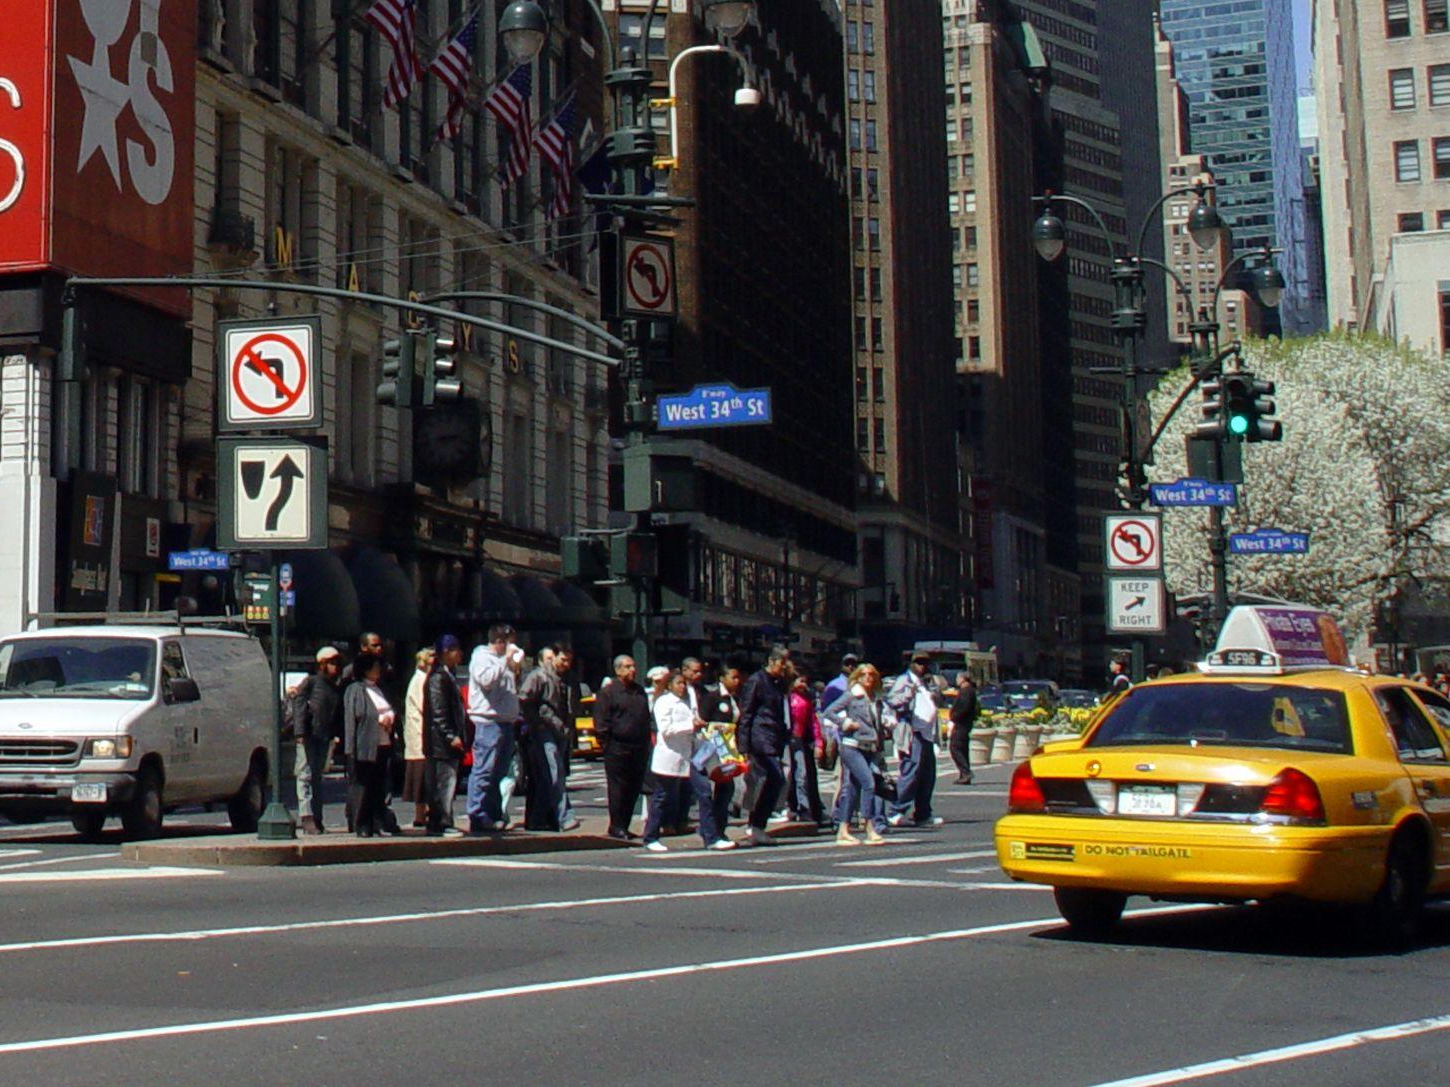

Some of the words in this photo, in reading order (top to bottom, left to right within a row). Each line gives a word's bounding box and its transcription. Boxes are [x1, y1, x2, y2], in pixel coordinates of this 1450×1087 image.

[666, 403, 706, 421] West
[711, 396, 743, 419] 34th
[747, 398, 764, 416] St
[1155, 489, 1186, 501] West
[1190, 488, 1215, 501] 34th
[1218, 489, 1231, 501] St
[1235, 538, 1265, 550] West
[1268, 537, 1291, 550] 34th
[1293, 538, 1305, 550] St
[173, 556, 197, 567] West
[197, 555, 215, 566] 34th
[216, 556, 226, 567] St
[1121, 582, 1149, 593] KEEP
[1119, 615, 1152, 625] RIGHT
[1085, 845, 1102, 854] DO
[1107, 846, 1130, 856] NOT
[1135, 847, 1190, 858] TAILGATE
